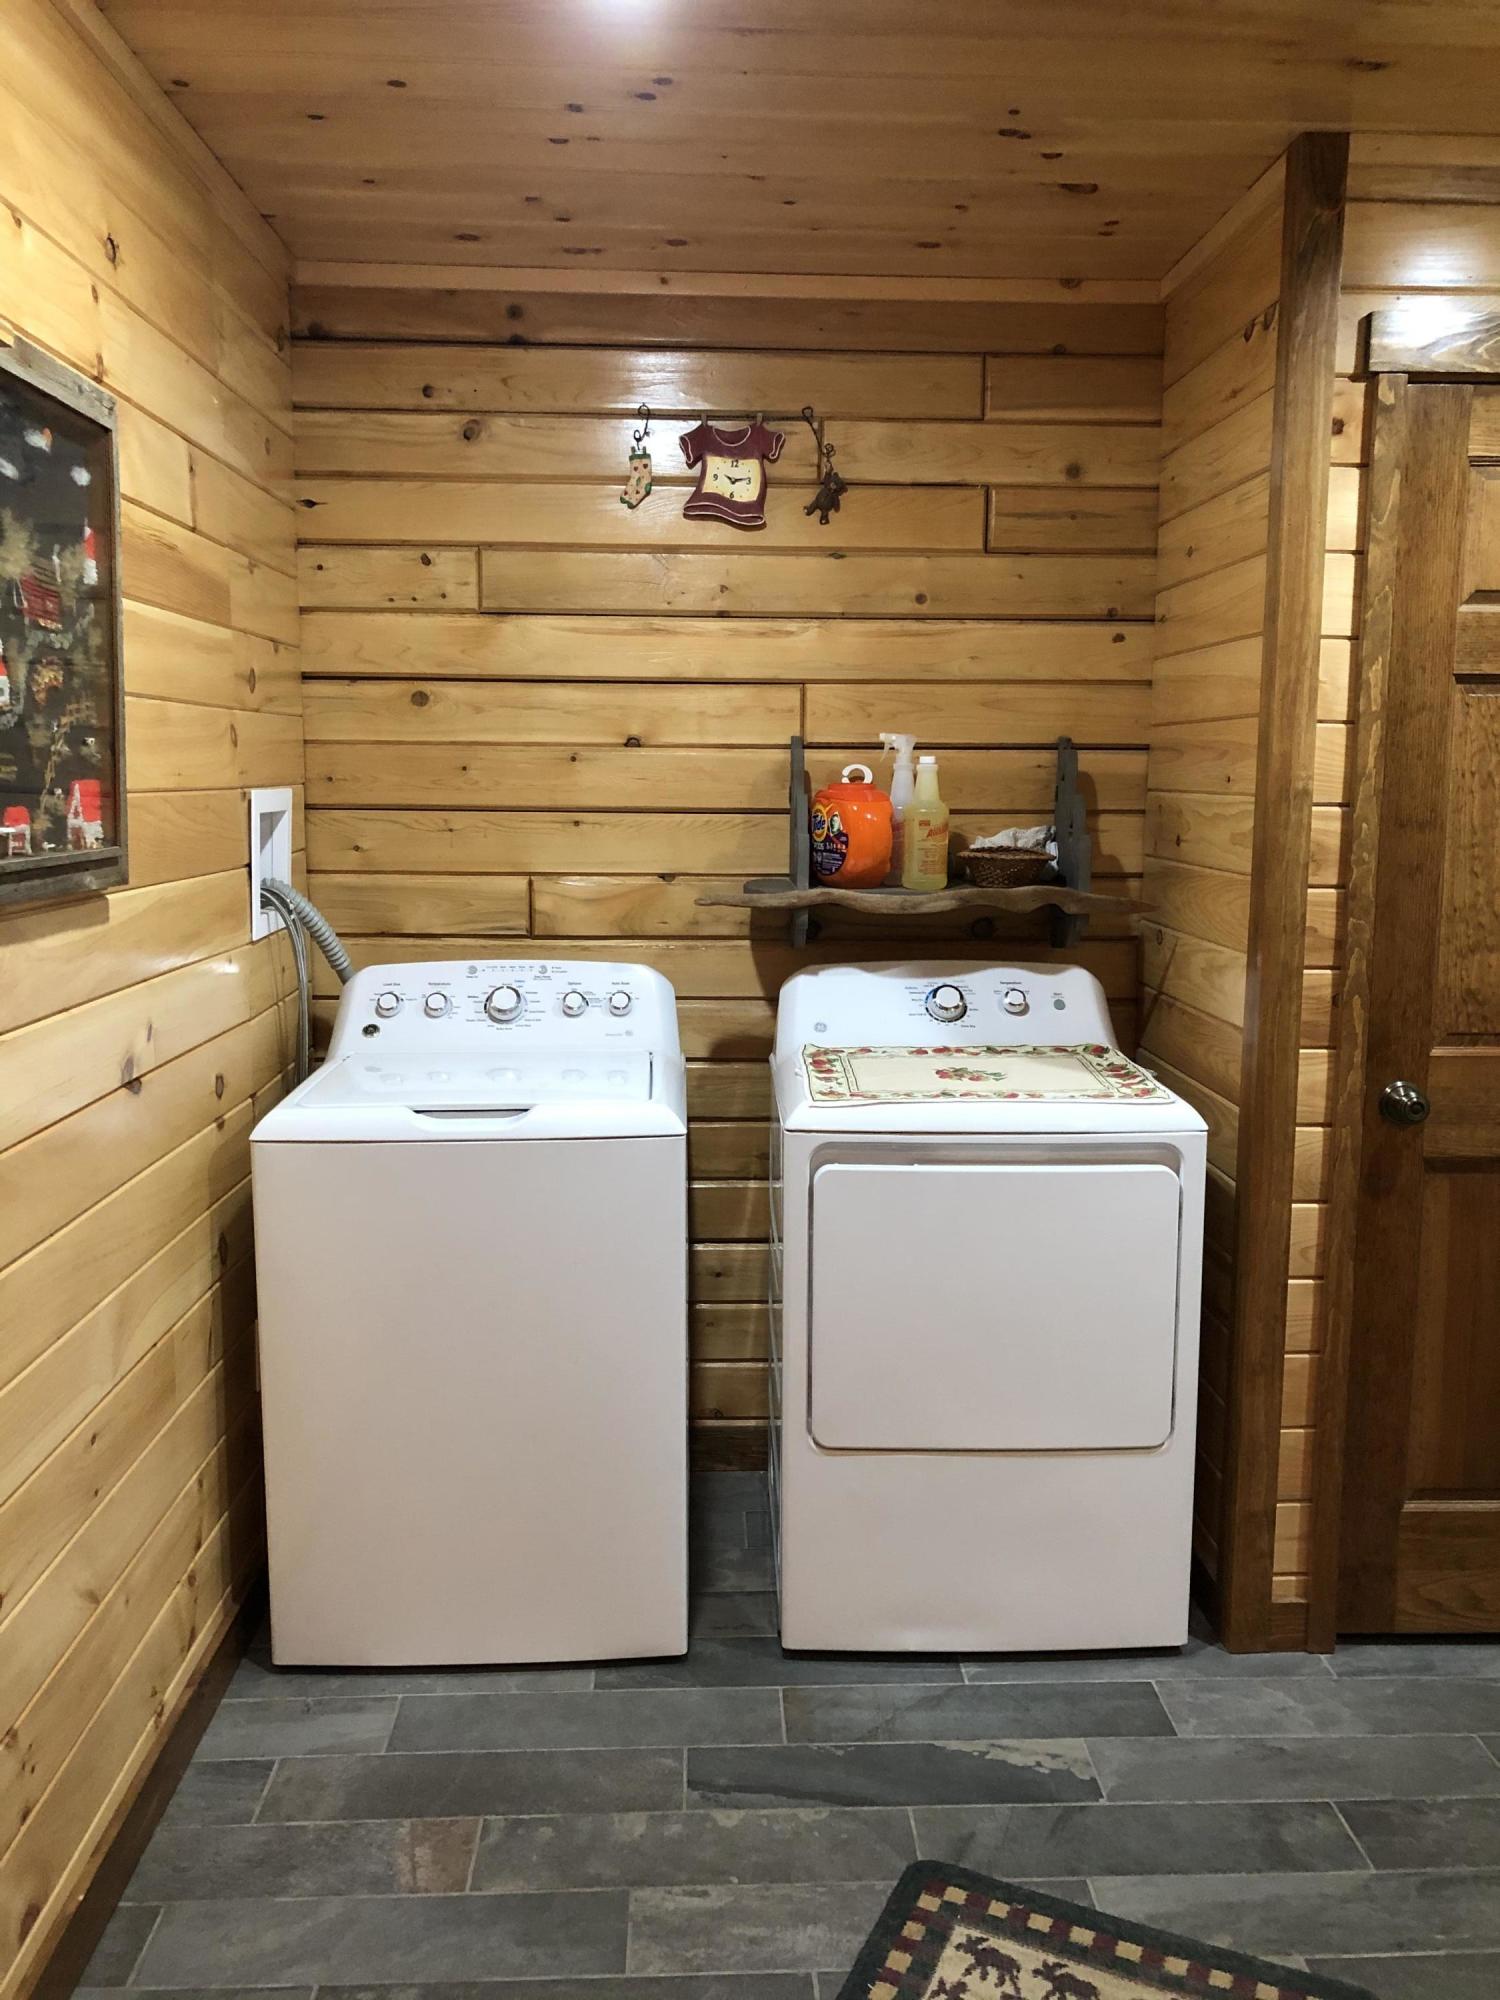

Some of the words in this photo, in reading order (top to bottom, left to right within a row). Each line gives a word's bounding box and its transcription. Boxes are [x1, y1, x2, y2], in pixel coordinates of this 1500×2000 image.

[730, 459, 739, 468] 12
[713, 473, 719, 481] 9
[746, 476, 752, 485] 3
[729, 491, 735, 499] 6
[811, 812, 827, 832] Tide
